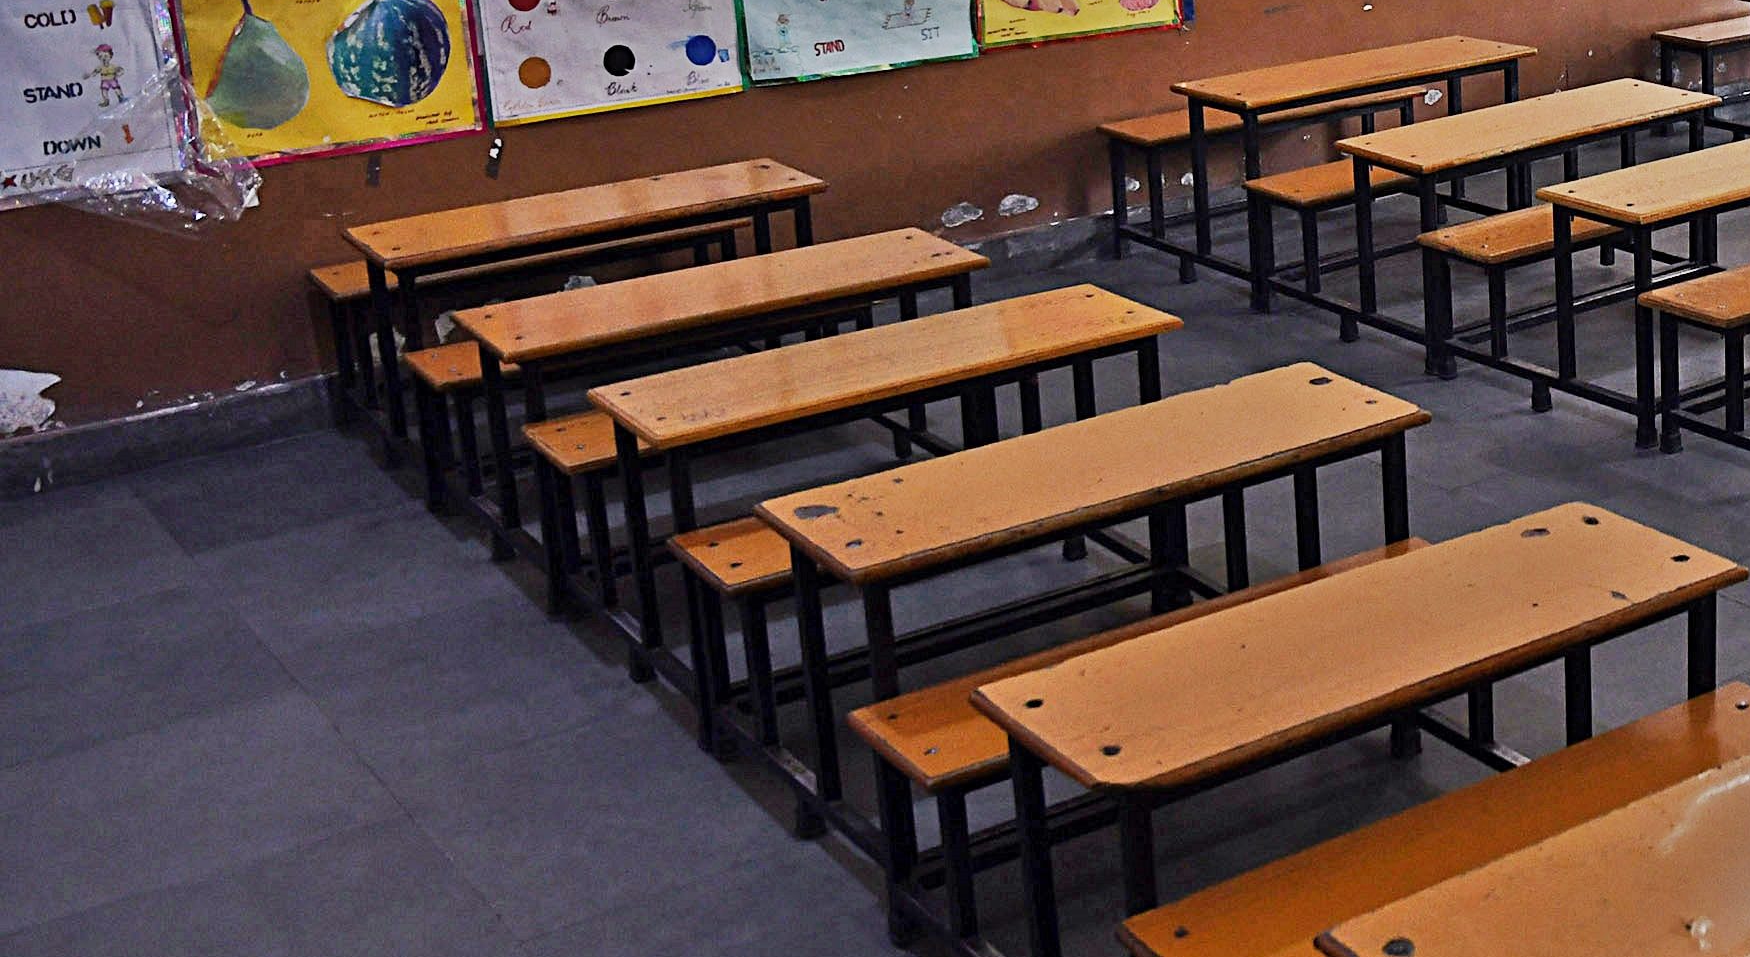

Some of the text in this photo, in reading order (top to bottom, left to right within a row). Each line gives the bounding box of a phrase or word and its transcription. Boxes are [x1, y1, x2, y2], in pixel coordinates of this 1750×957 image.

[23, 8, 77, 29] COLD
[814, 26, 940, 55] STAND SIT
[23, 82, 84, 102] STAND
[43, 136, 101, 155] DOWN
